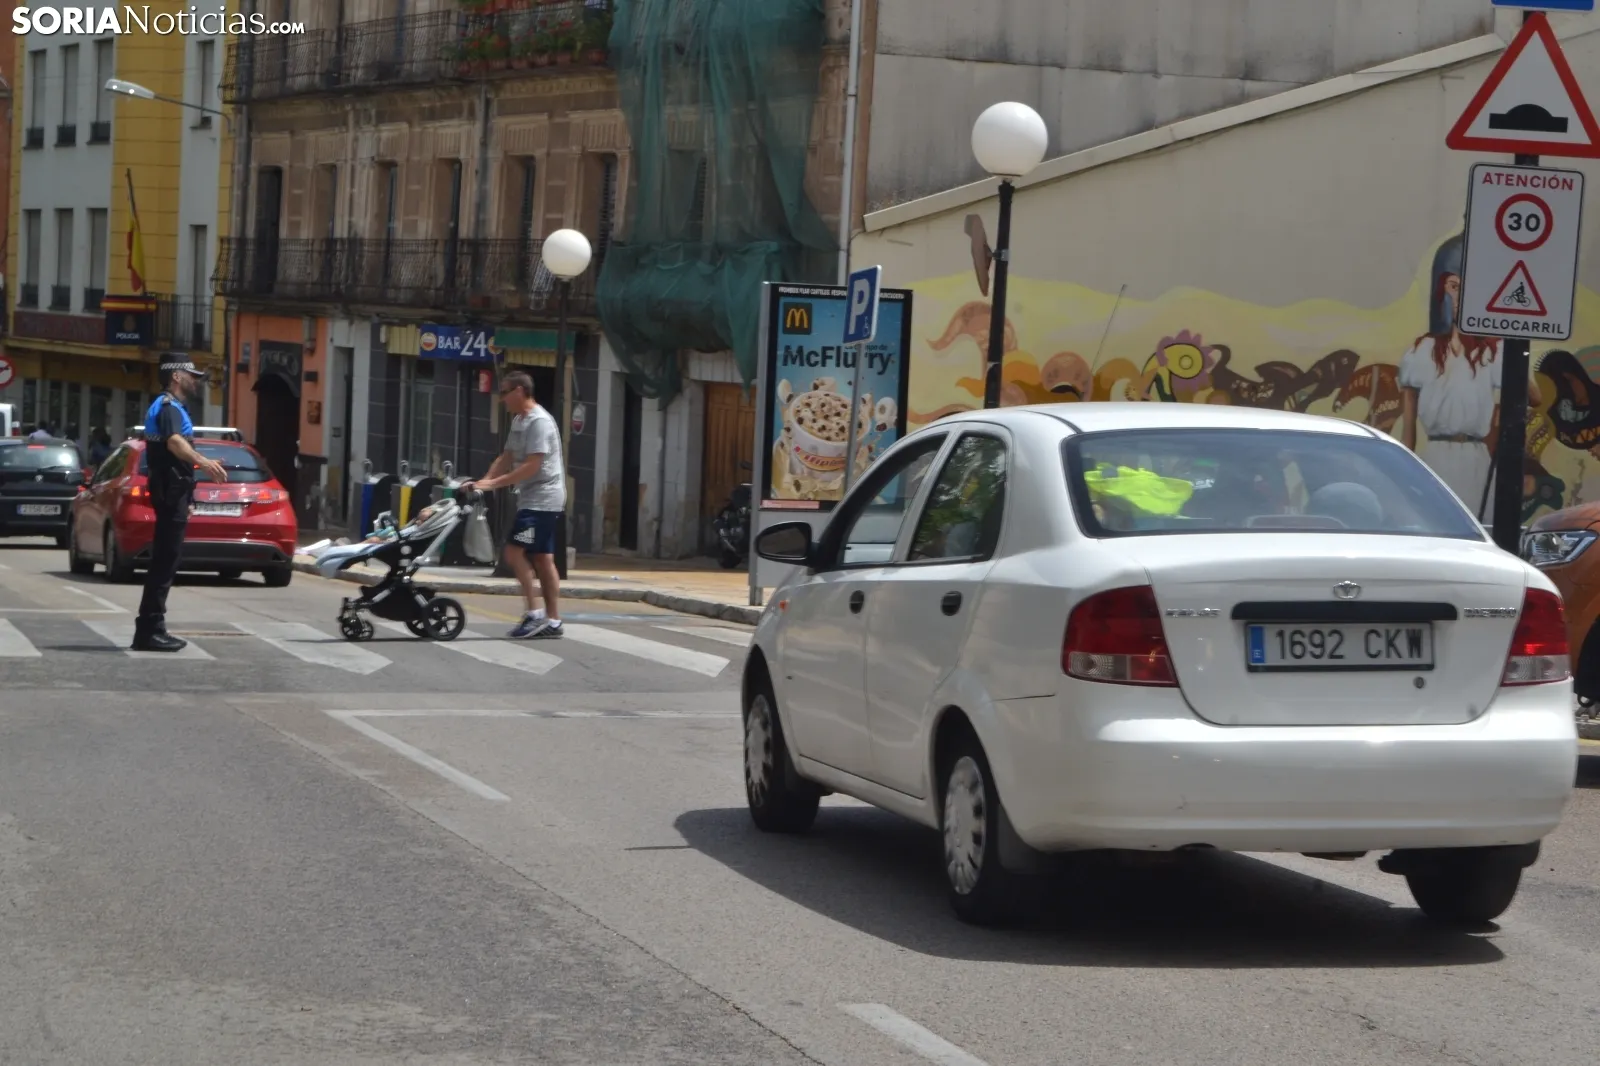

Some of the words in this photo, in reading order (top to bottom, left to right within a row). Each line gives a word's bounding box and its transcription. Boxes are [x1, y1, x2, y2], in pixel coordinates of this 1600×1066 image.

[1482, 172, 1574, 191] ATENCIÓN
[1507, 212, 1541, 232] 30
[848, 278, 870, 335] P
[1466, 316, 1565, 335] CICLOCARRIL
[438, 336, 461, 349] BAR
[460, 330, 487, 357] 24
[1275, 628, 1344, 660] 1692
[1363, 628, 1423, 659] CKW
